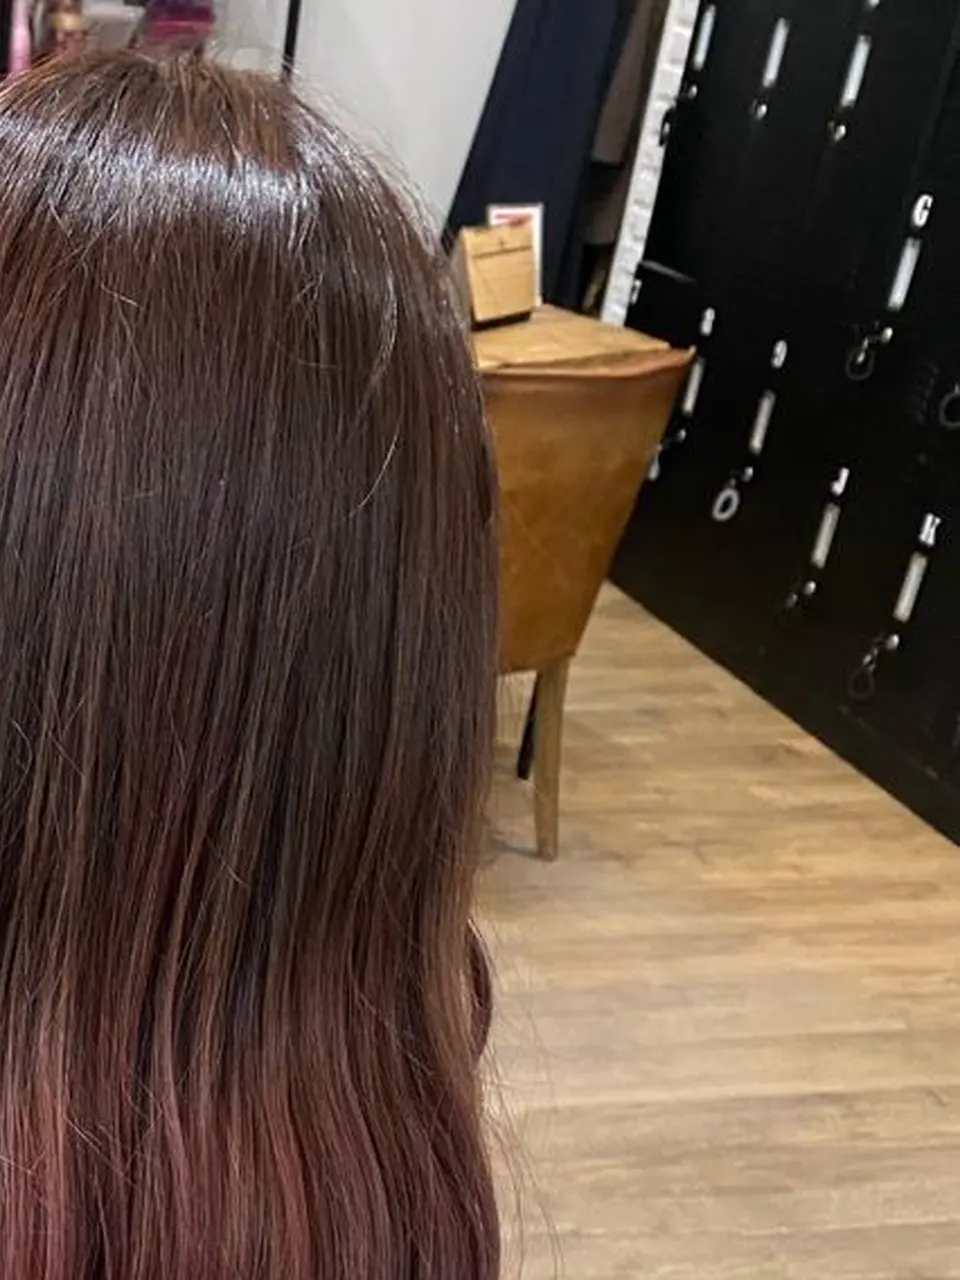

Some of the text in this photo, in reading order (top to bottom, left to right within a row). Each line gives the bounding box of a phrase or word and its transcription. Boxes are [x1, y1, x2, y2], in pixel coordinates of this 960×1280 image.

[913, 194, 933, 227] G
[771, 340, 787, 368] 9
[832, 467, 849, 496] J
[920, 513, 941, 546] K
